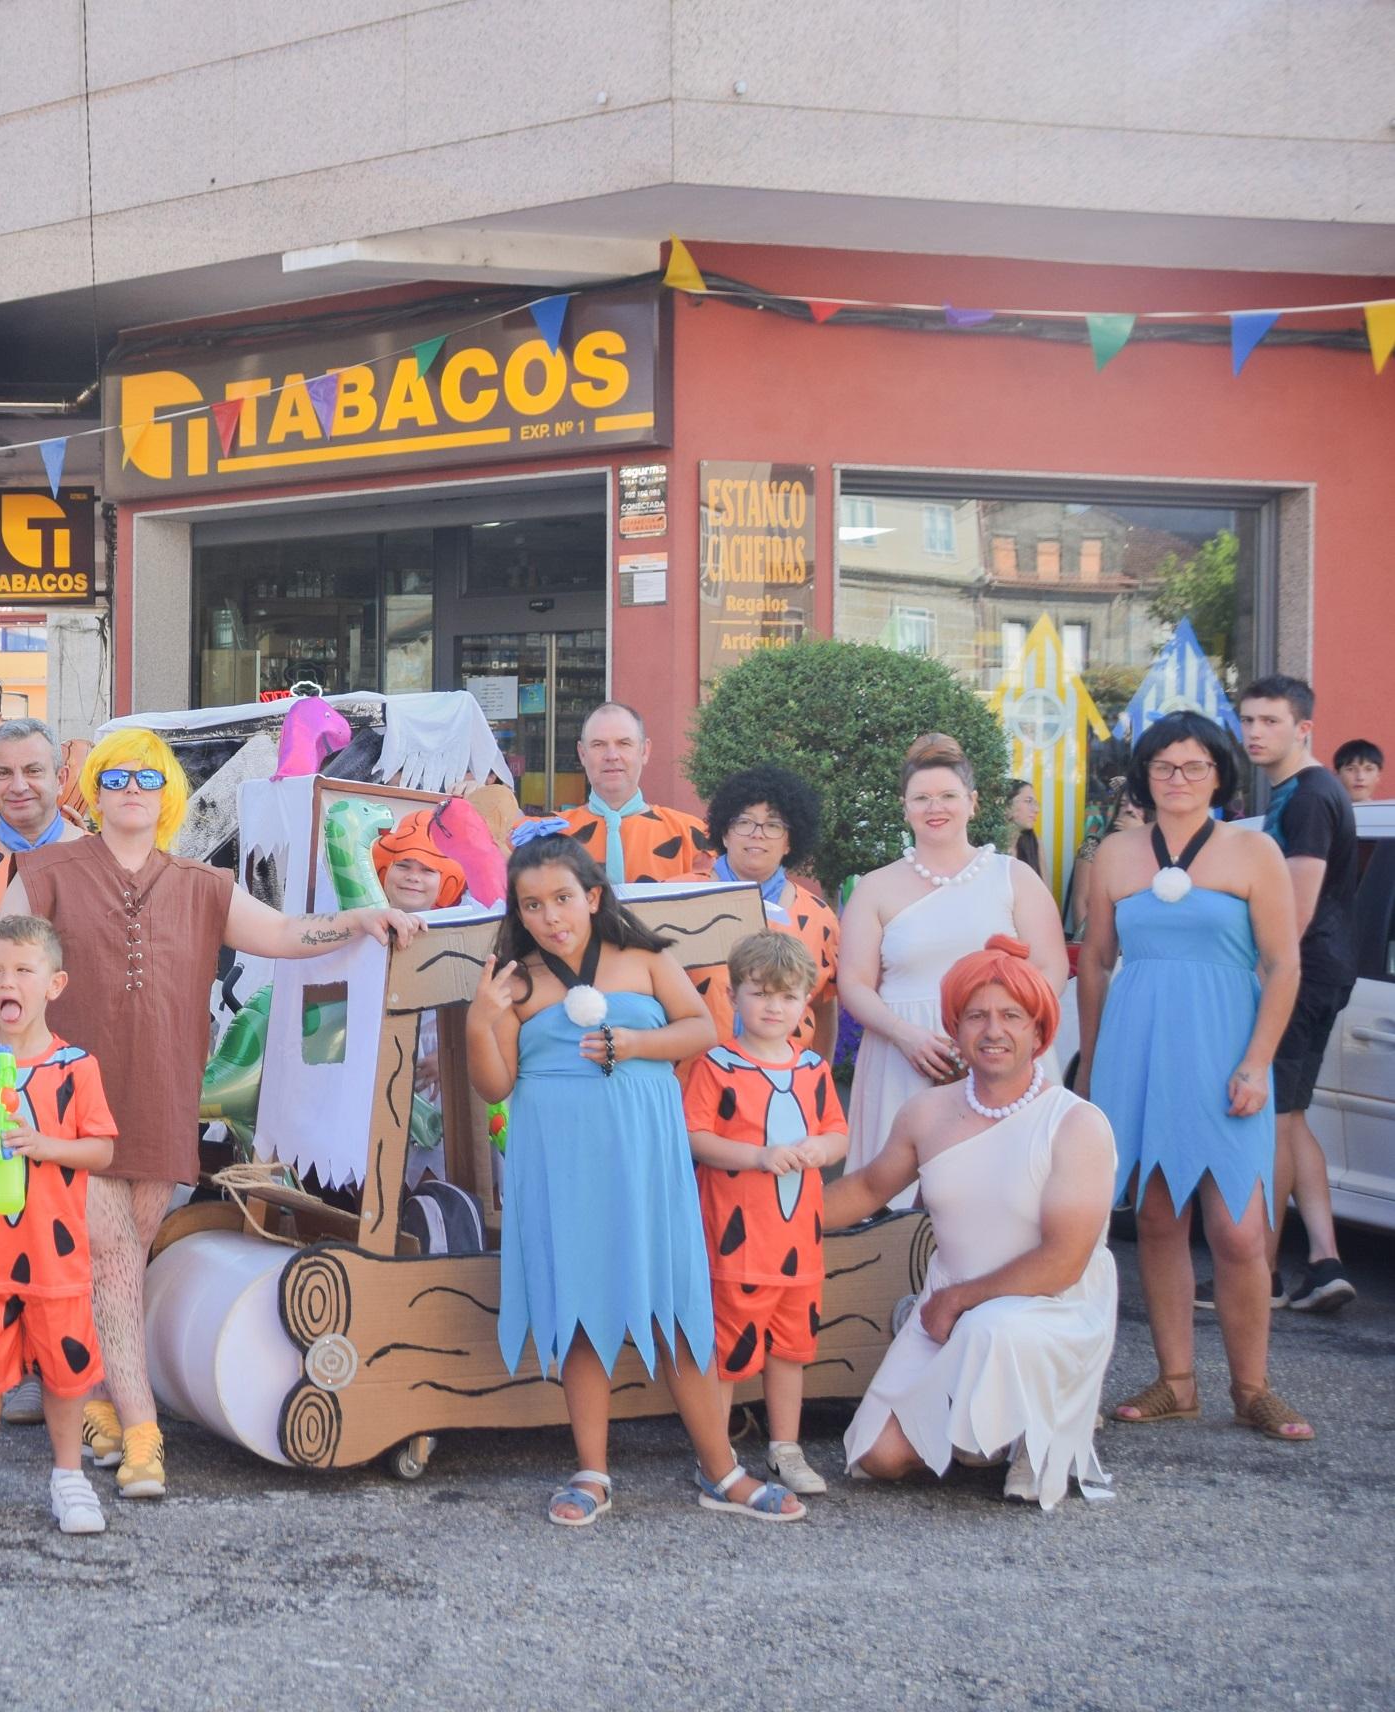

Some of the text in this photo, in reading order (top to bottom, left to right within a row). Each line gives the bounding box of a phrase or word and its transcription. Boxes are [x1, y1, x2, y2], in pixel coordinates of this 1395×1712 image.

[225, 330, 629, 448] TABACOS
[520, 420, 584, 440] EXP. Nº 1
[621, 501, 665, 511] CONECTADA
[707, 479, 805, 529] ESTANCO
[707, 535, 806, 583] CACHEIRAS
[726, 594, 789, 616] Regalos
